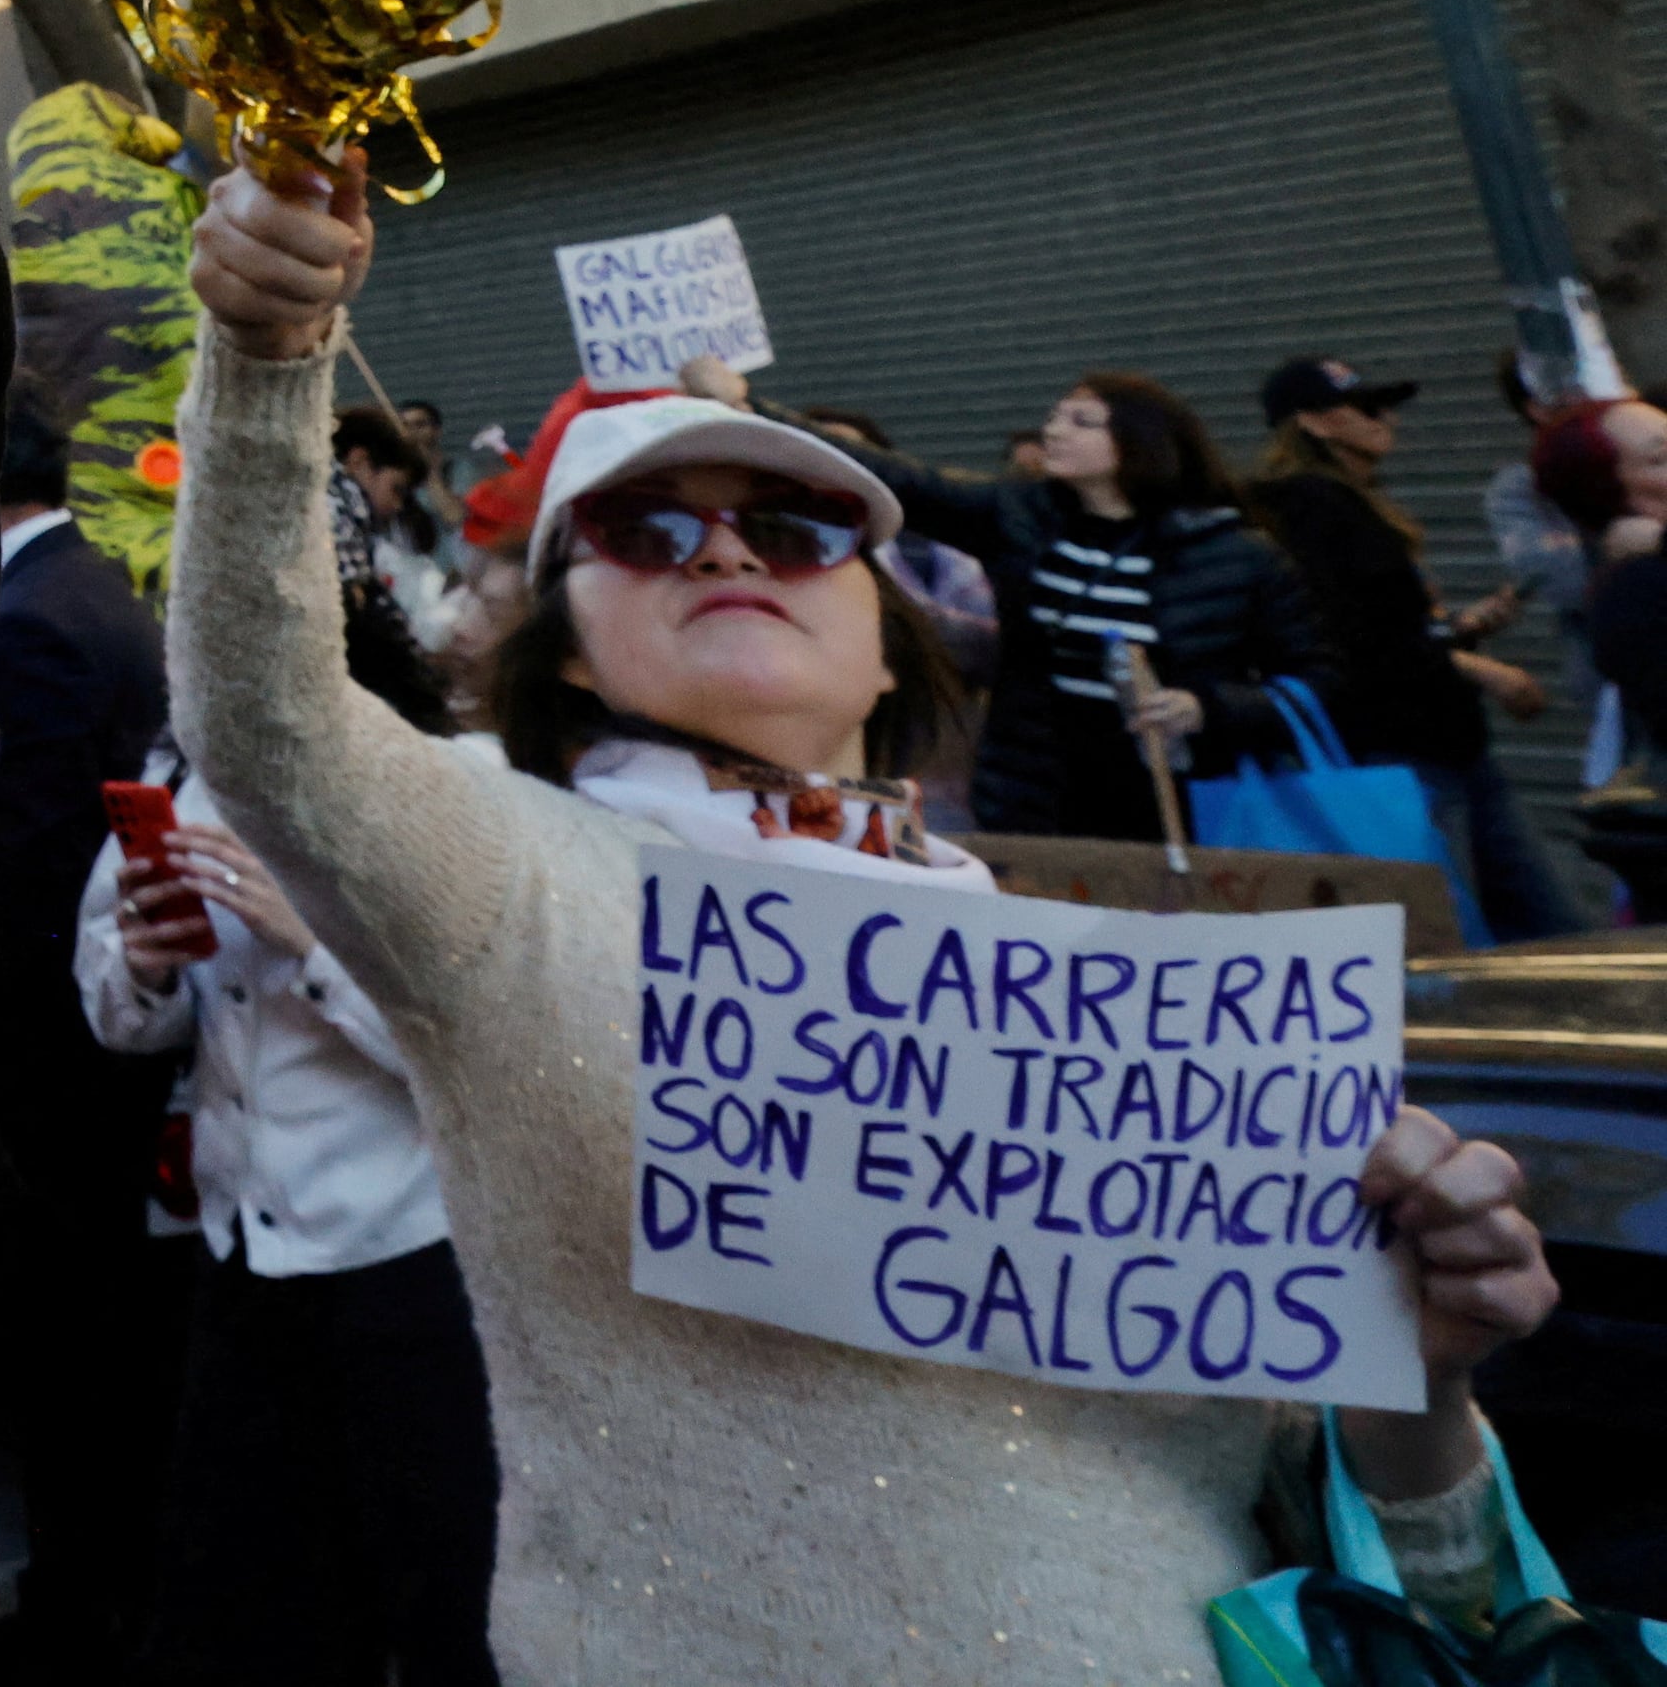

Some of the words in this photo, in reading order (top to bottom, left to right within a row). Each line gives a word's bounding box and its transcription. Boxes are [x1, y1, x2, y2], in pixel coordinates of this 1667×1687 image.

[640, 875, 806, 995] LAS
[845, 911, 1375, 1052] CARRERAS
[640, 984, 755, 1082] NO
[775, 1009, 950, 1117] SON
[647, 1076, 812, 1182] SON
[642, 1162, 774, 1267] DE
[873, 1226, 1349, 1382] GALGOS
